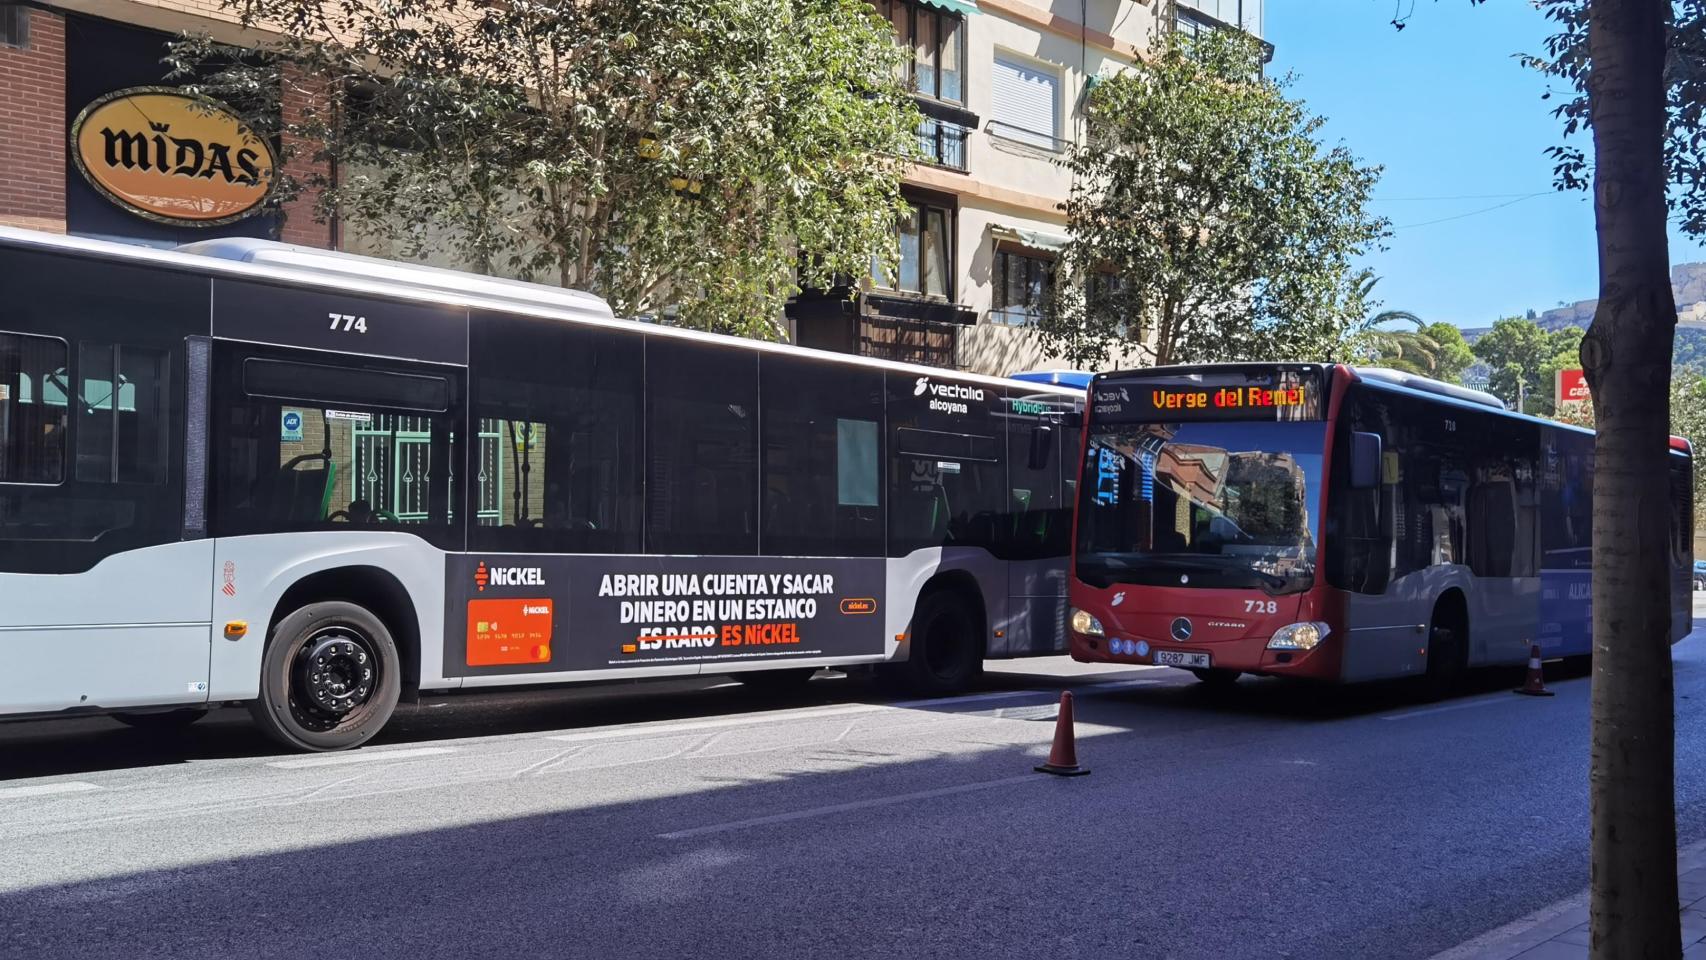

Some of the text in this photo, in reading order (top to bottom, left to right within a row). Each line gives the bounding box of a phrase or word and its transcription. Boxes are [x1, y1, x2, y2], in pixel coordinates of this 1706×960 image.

[329, 313, 367, 333] 774
[929, 383, 984, 401] vectalia
[1152, 386, 1305, 408] Verge del Remei
[1569, 387, 1591, 396] CEP
[929, 398, 968, 415] alcoyana
[598, 573, 834, 597] ABRIR UNA CUENTA Y SACAR
[1568, 583, 1593, 600] ALICA
[620, 598, 817, 623] DINERO EN UN ESTANCO
[1244, 600, 1277, 614] 728
[640, 627, 662, 650] ES
[665, 625, 716, 649] RARO
[721, 625, 741, 646] ES
[1160, 653, 1206, 665] 9287 JMF
